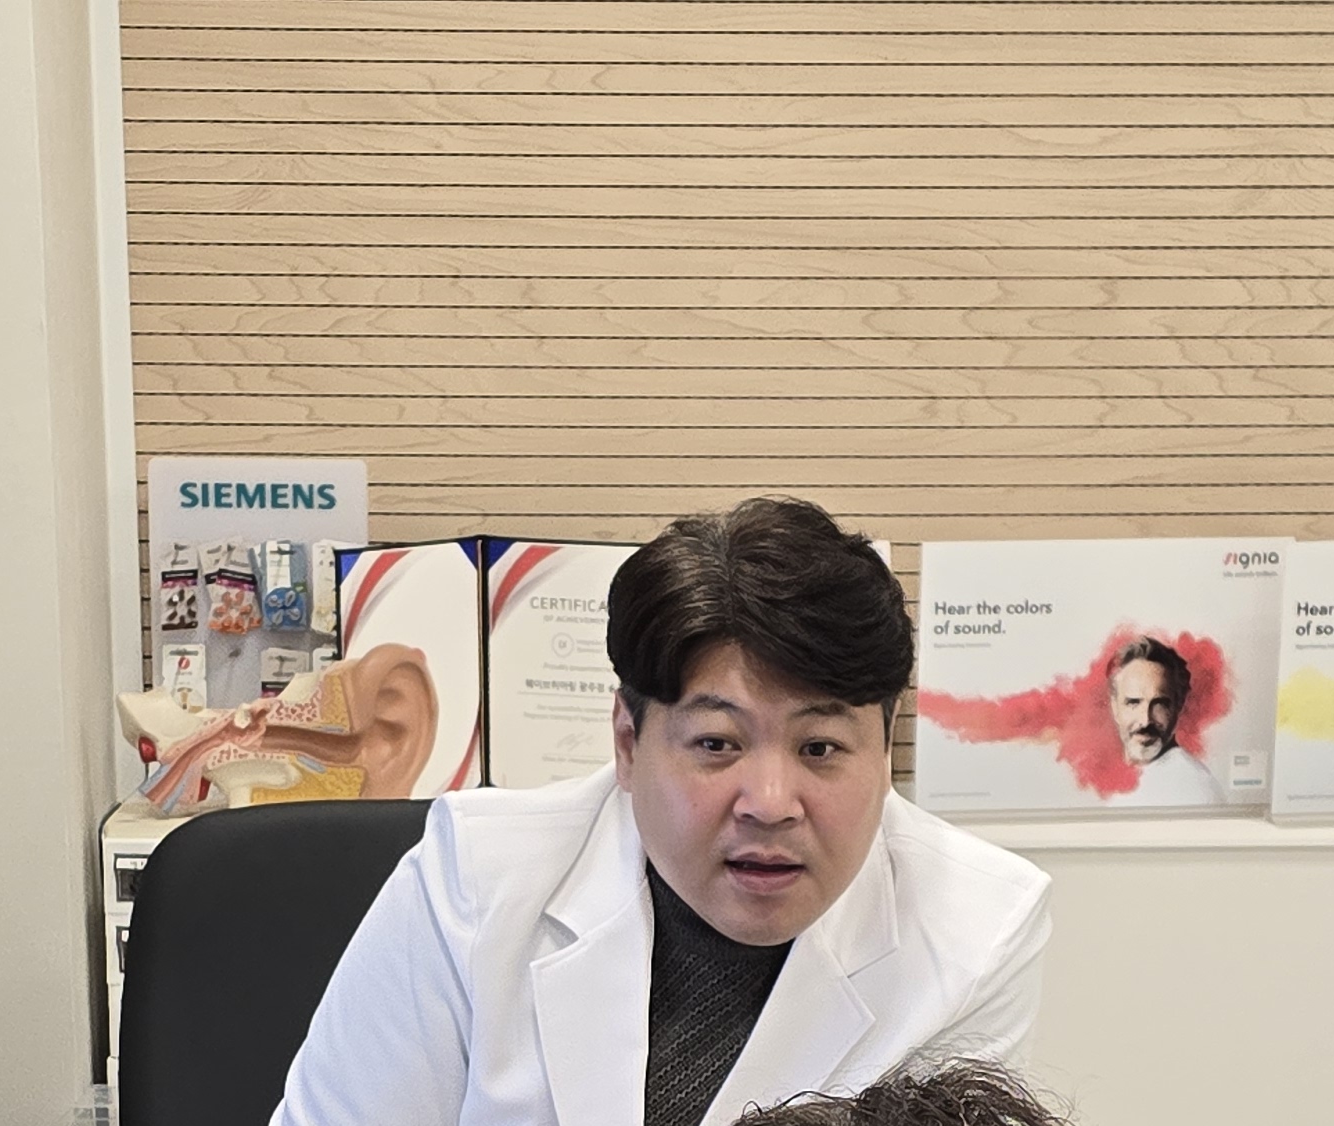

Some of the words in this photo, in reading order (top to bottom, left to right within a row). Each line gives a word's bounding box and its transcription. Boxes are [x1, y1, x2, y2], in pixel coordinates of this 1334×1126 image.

[179, 482, 337, 510] SIEMENS
[1223, 551, 1279, 569] signia
[530, 596, 608, 612] CERTIFICA
[934, 600, 972, 615] Hear
[976, 600, 1001, 615] the
[1006, 599, 1053, 615] colors
[1296, 600, 1334, 616] Hear
[933, 620, 950, 635] of
[953, 620, 1006, 635] sound.
[1295, 620, 1312, 636] of
